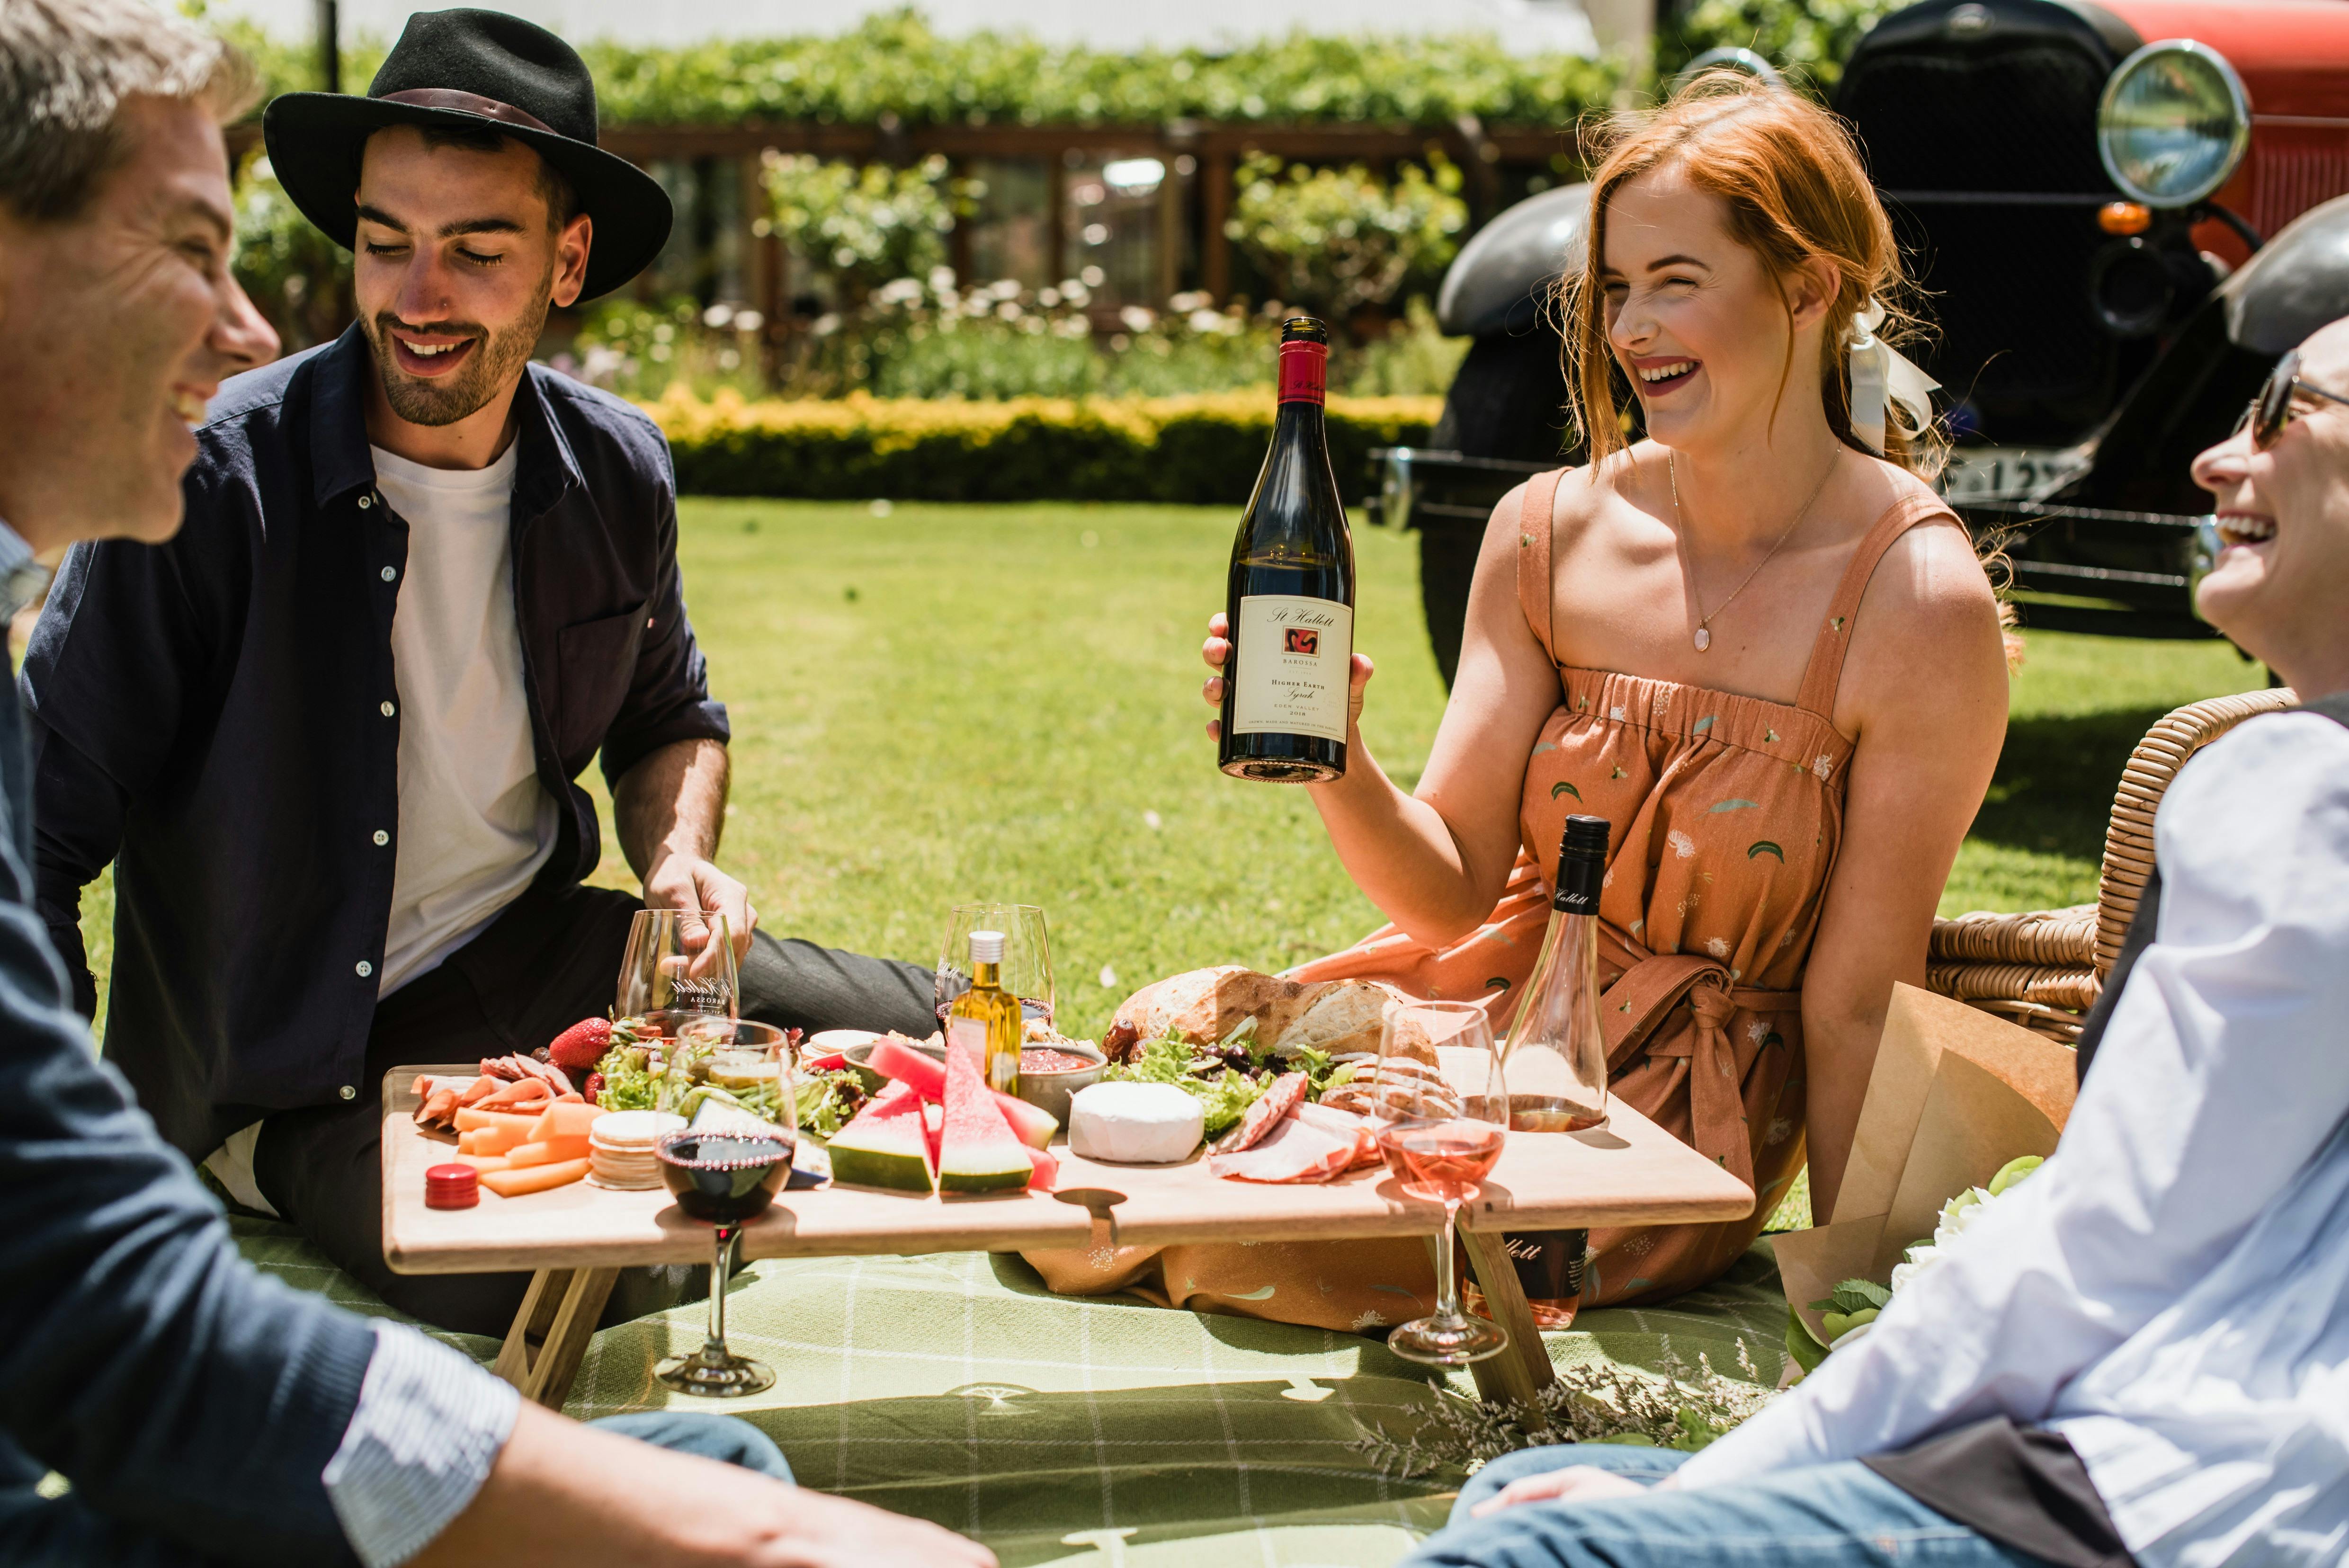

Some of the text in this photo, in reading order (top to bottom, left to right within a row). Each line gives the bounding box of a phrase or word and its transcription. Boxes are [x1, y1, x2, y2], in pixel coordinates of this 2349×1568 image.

[1267, 607, 1334, 627] St Hallett
[1283, 659, 1317, 667] BAROSSA
[1284, 686, 1314, 702] Syrah
[1304, 682, 1325, 690] EARTH
[1554, 887, 1589, 905] Hallett
[1506, 1238, 1542, 1260] llett
